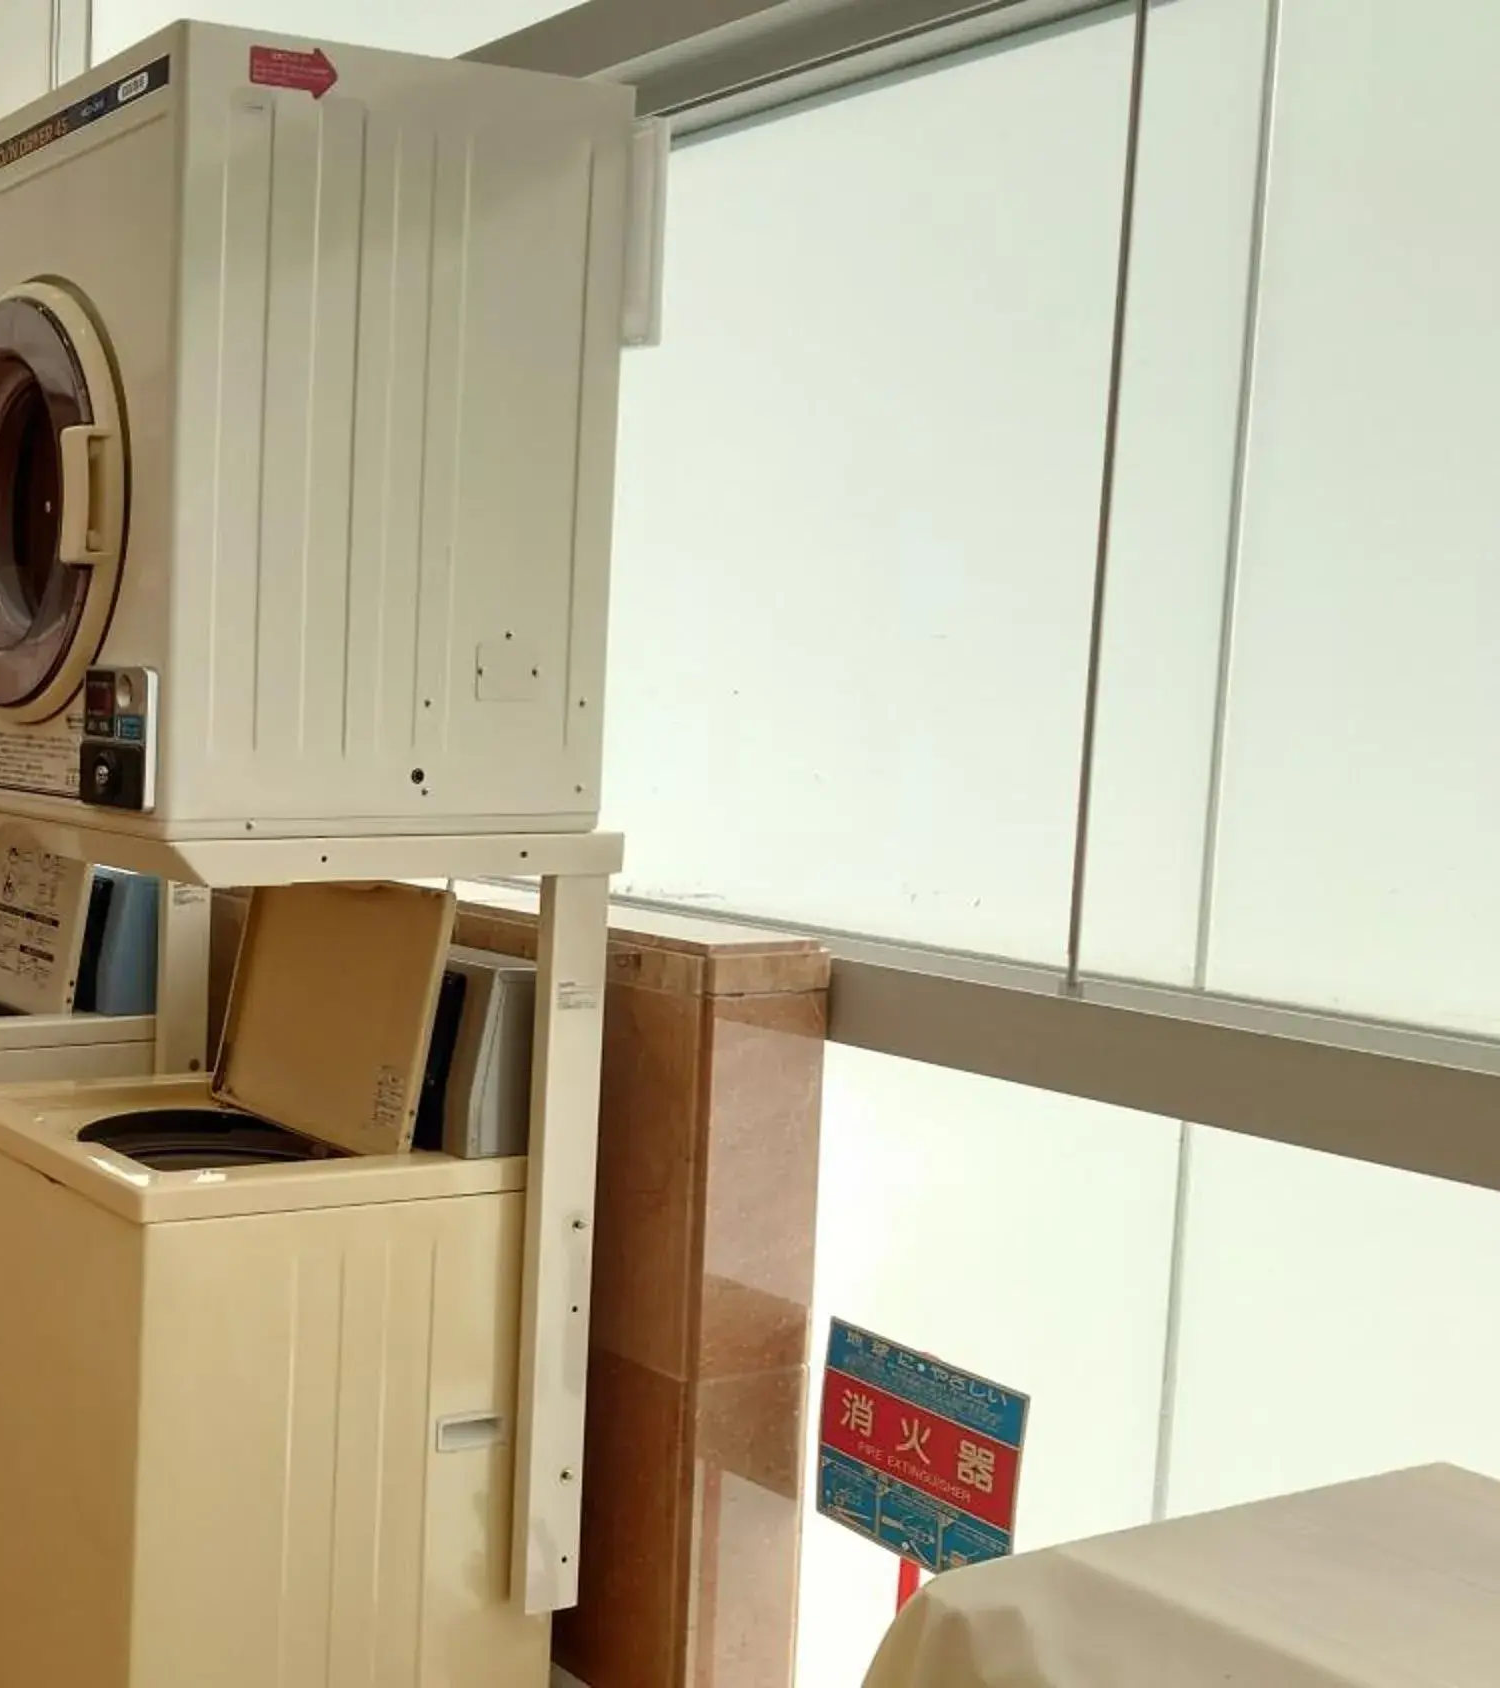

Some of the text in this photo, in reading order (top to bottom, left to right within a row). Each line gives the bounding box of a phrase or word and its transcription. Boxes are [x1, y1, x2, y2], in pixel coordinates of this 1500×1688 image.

[841, 1389, 995, 1493] 消火器
[858, 1441, 884, 1461] FIRE
